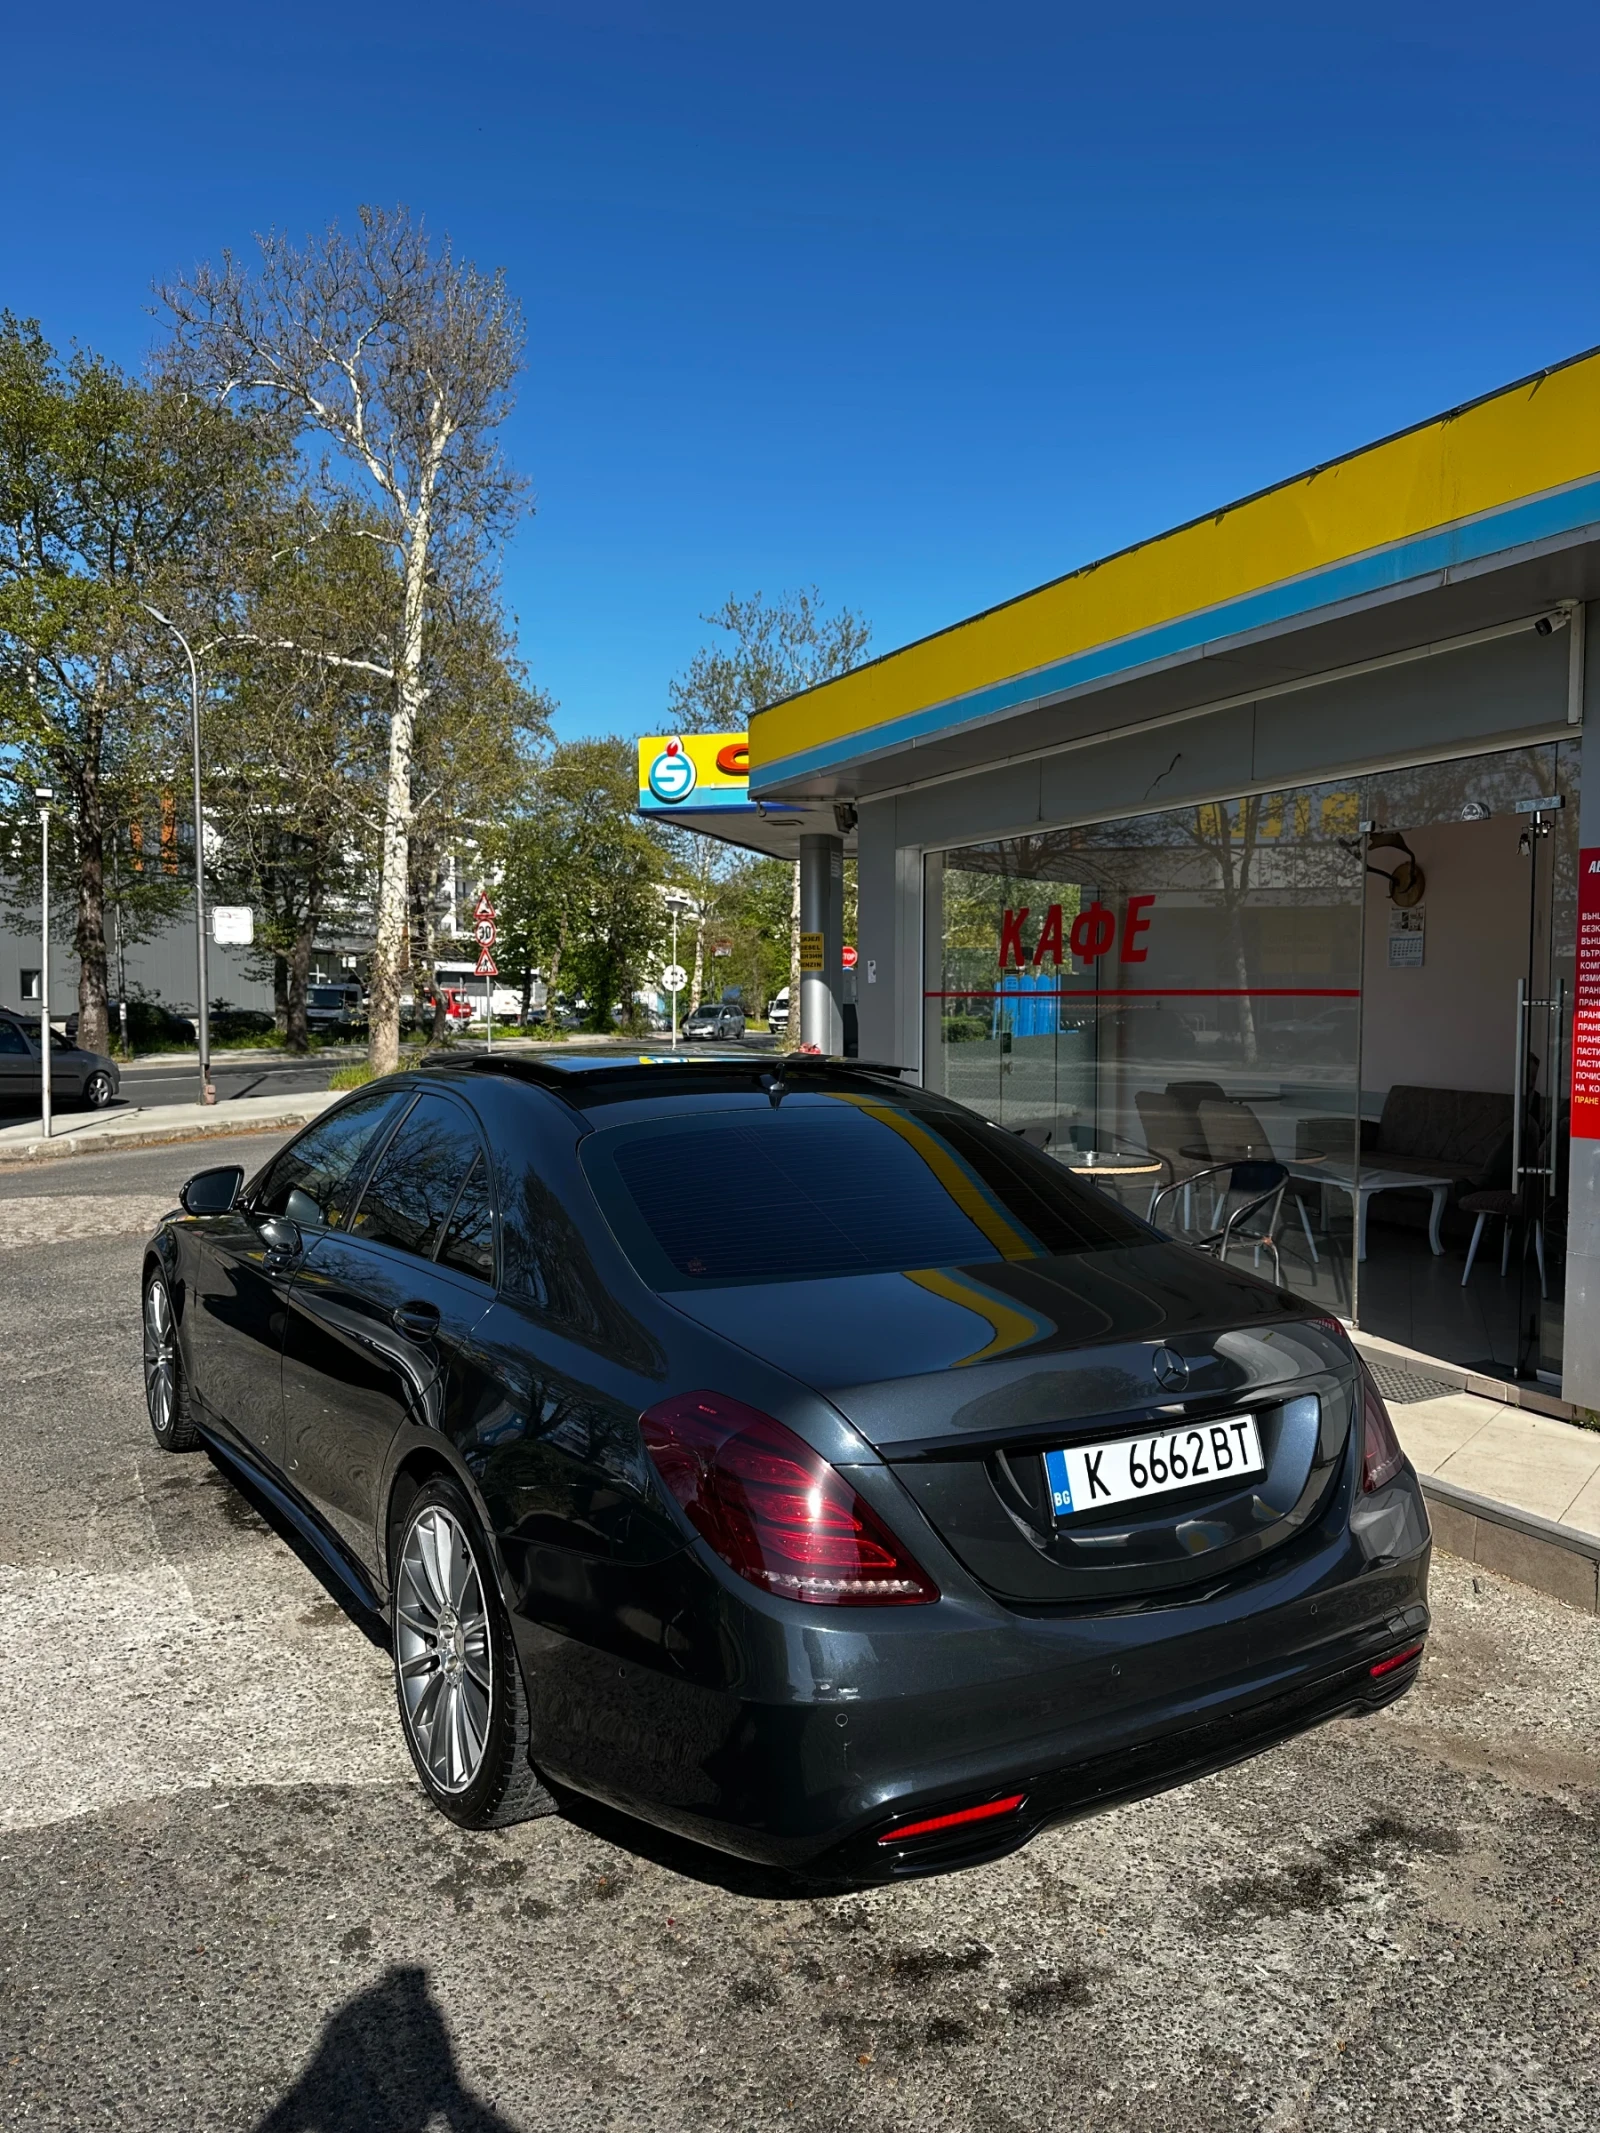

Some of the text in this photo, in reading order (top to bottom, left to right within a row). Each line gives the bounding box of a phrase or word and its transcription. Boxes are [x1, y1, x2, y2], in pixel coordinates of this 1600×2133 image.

[479, 925, 492, 941] 30
[998, 894, 1156, 967] КАФЕ
[1575, 1083, 1600, 1093] НА КО
[1574, 1095, 1599, 1105] ПРАНЕ
[1085, 1422, 1247, 1499] K 6662BT
[1053, 1490, 1071, 1508] BG
